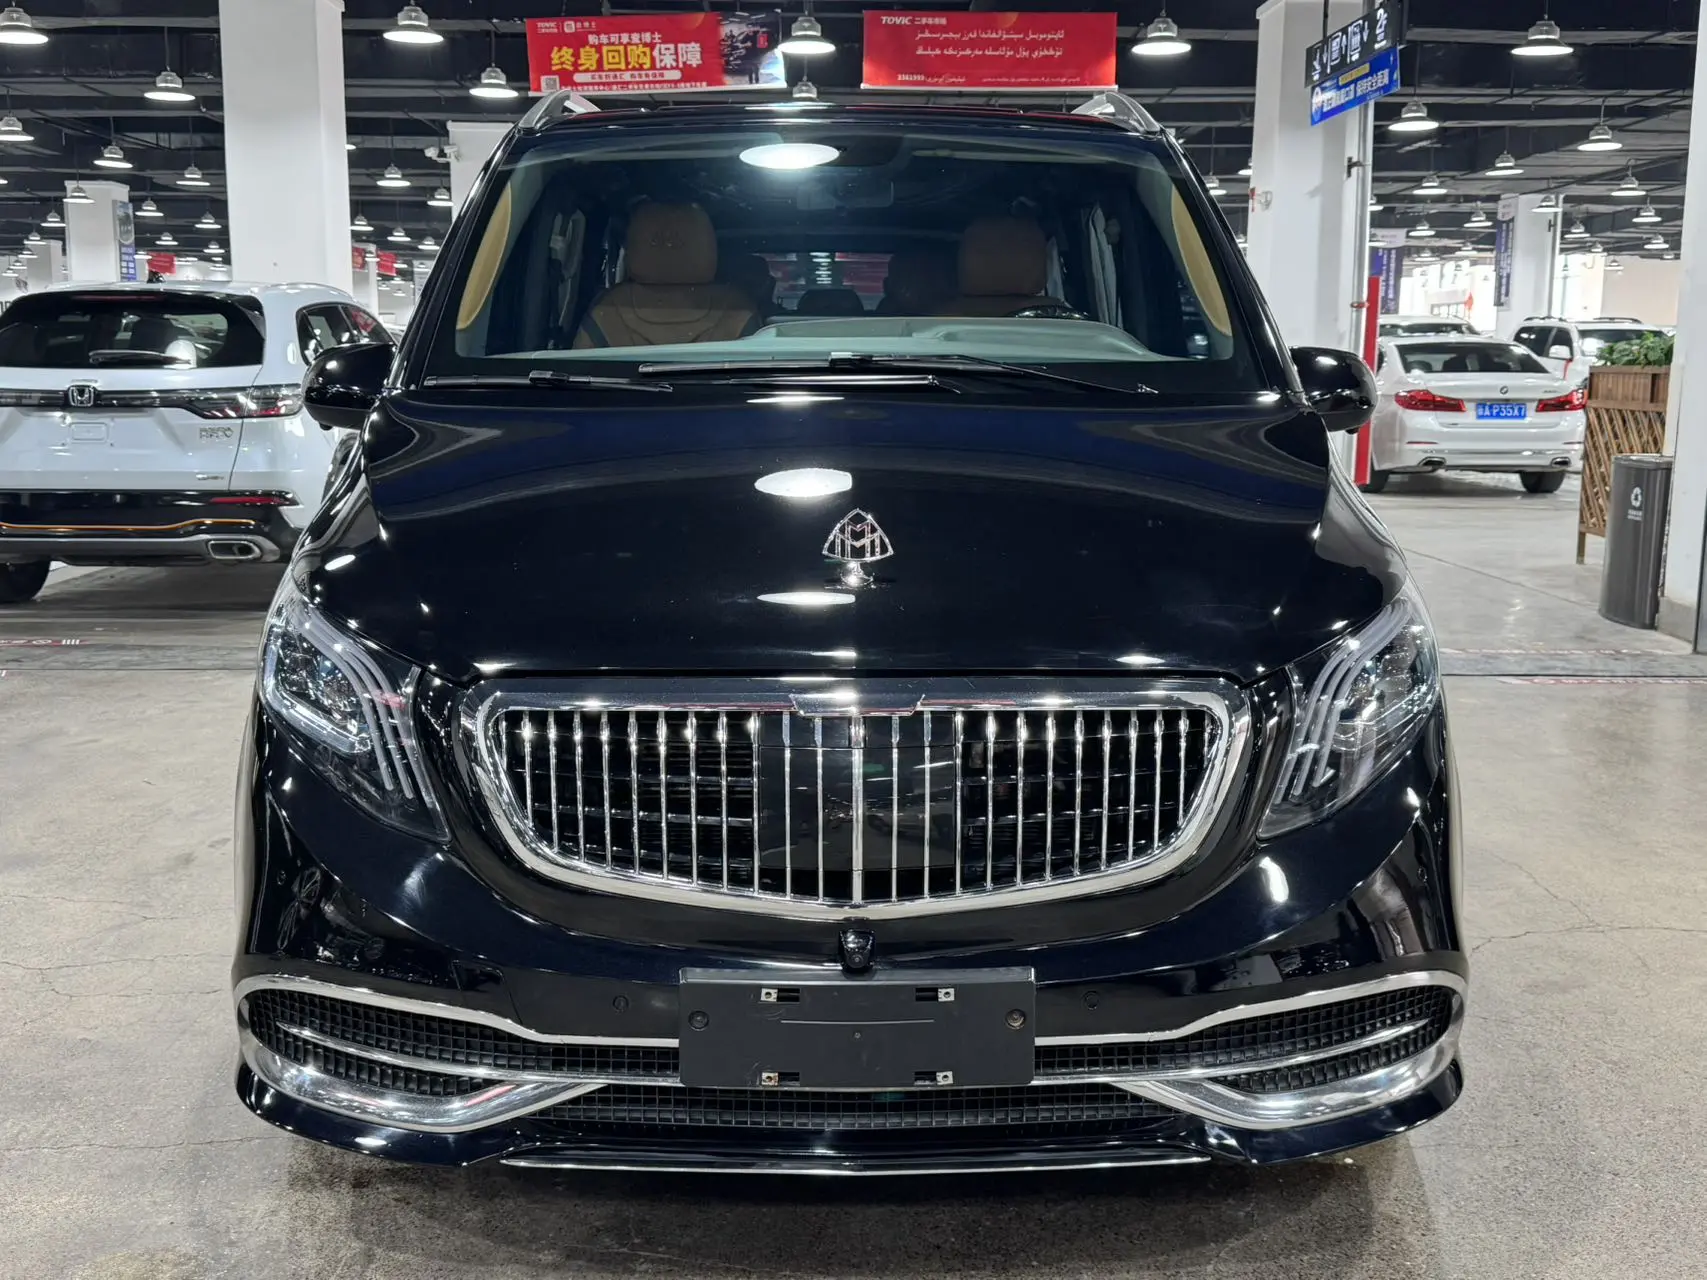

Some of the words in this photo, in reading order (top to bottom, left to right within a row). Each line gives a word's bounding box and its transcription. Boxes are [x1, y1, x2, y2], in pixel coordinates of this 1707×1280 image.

[880, 16, 912, 25] TOVIC
[587, 32, 662, 45] 购车可享查博士
[551, 42, 702, 71] 终身回购保障
